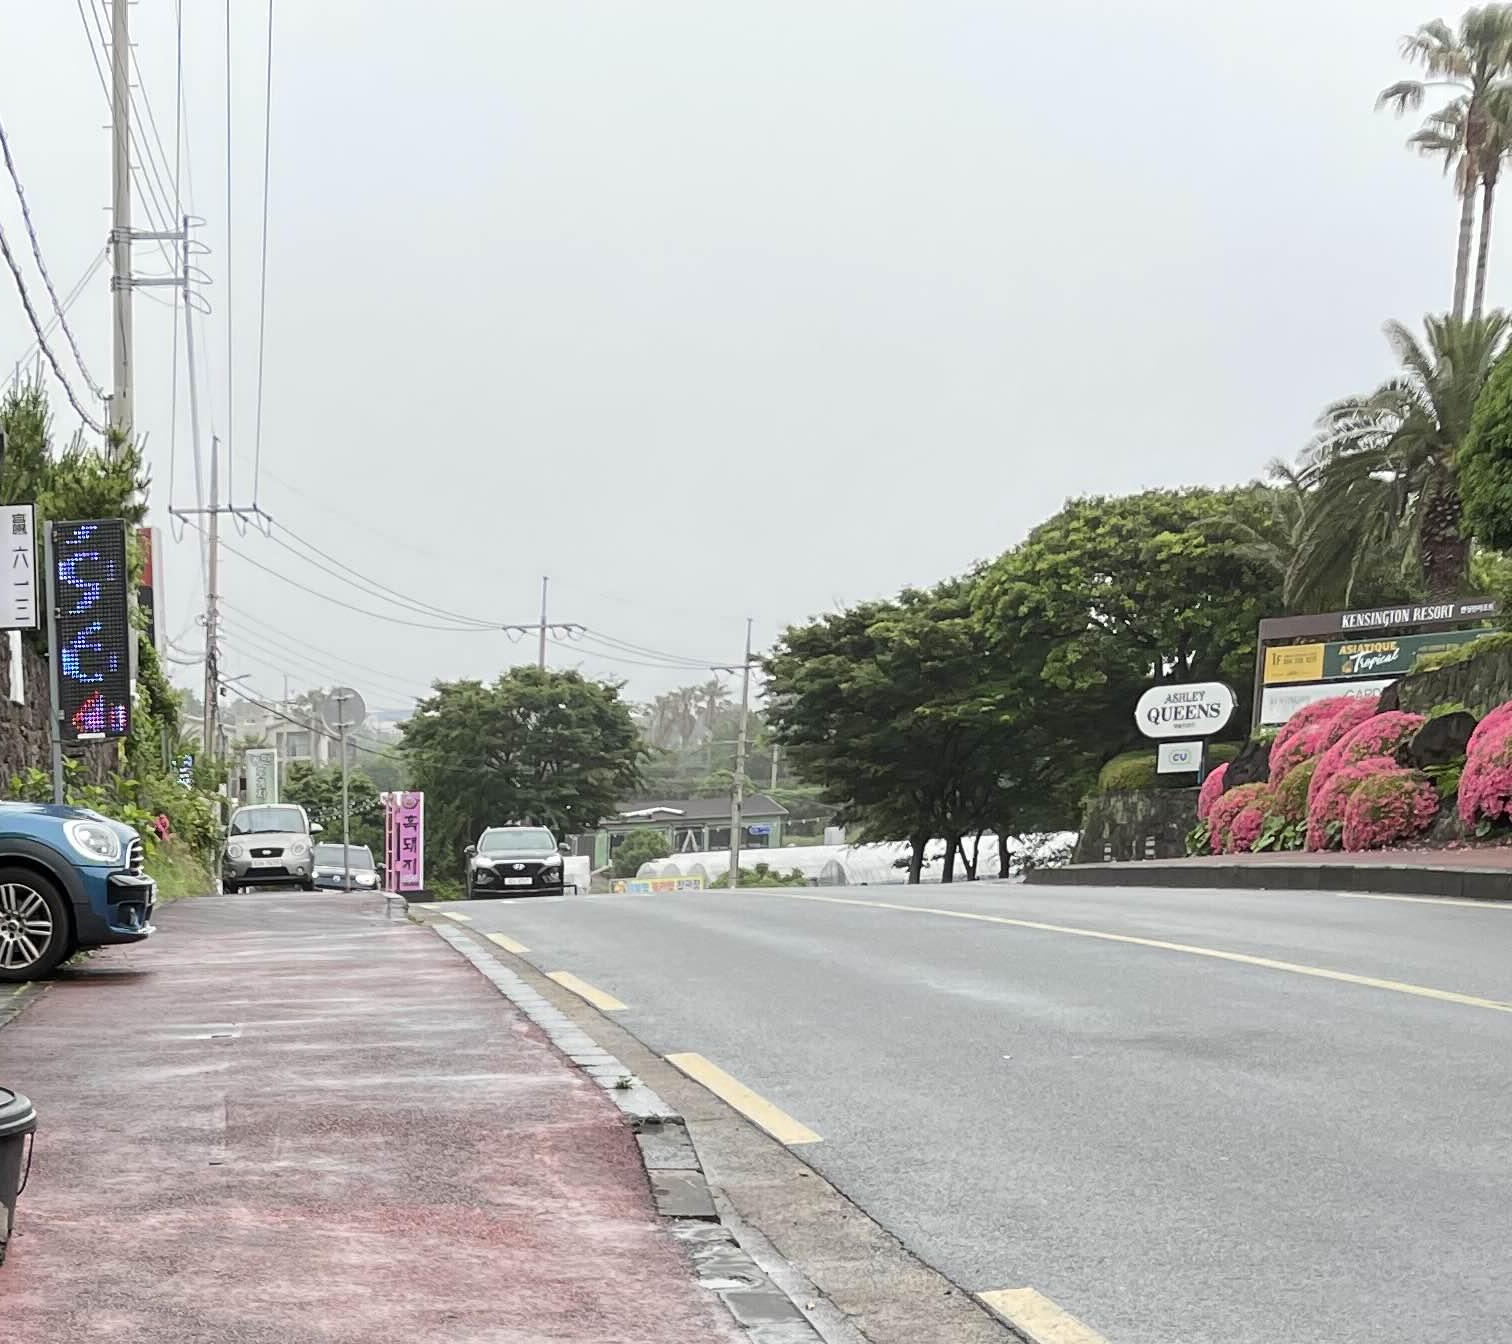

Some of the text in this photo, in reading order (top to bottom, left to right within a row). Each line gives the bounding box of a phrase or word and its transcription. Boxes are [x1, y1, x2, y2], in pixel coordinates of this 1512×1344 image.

[1342, 608, 1410, 628] KENSINGTON
[1412, 604, 1455, 622] RESORT
[1339, 641, 1397, 655] ASIATIQUE
[1349, 648, 1400, 673] Tropical
[1164, 691, 1206, 704] ASHLEY
[1147, 703, 1221, 725] QUEENS
[1172, 752, 1188, 762] CU
[402, 815, 419, 876] 흑돼지
